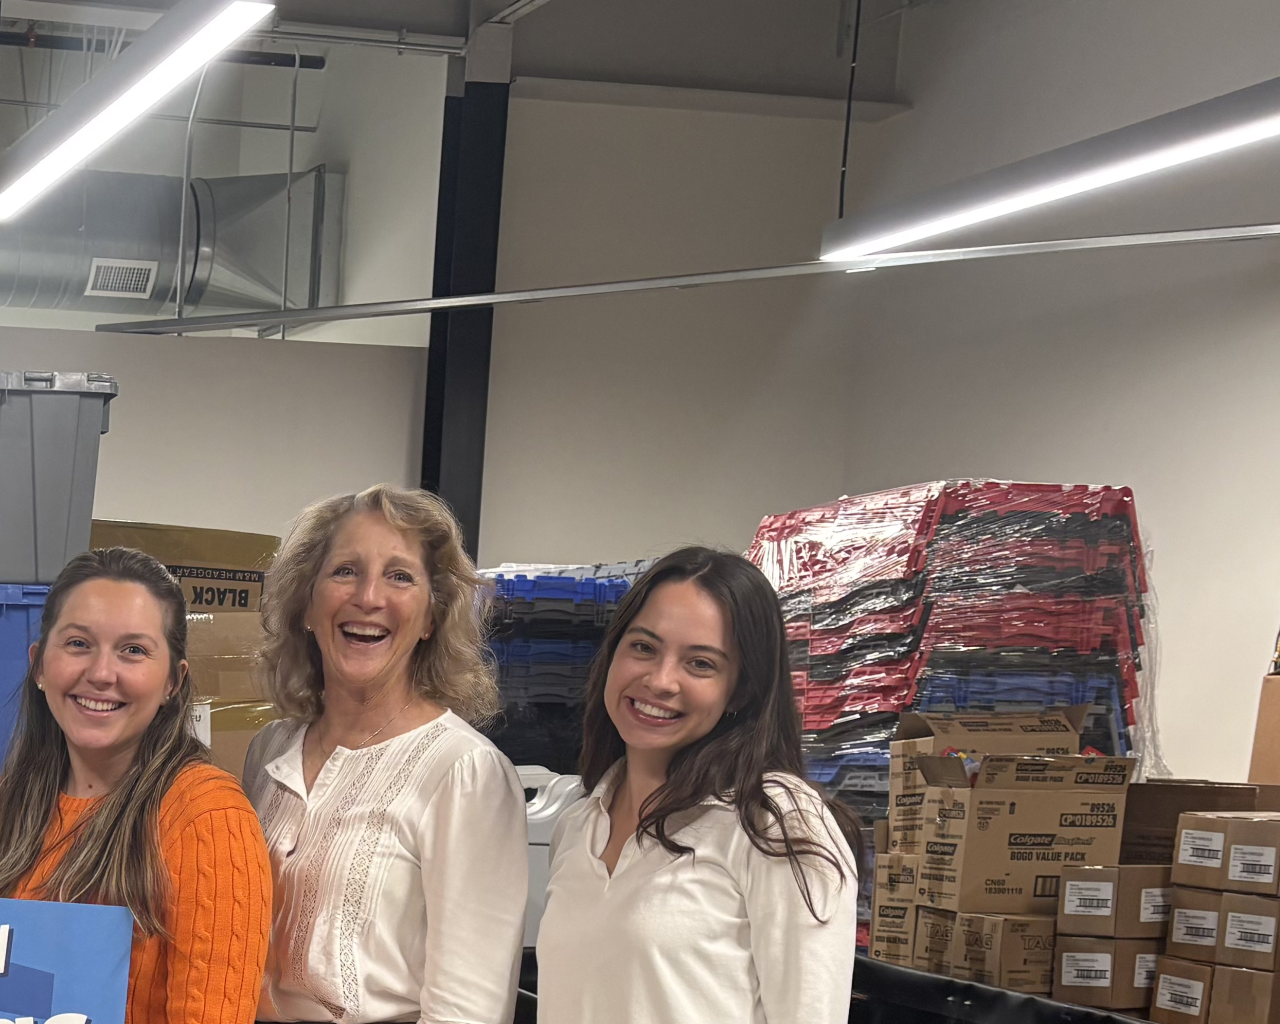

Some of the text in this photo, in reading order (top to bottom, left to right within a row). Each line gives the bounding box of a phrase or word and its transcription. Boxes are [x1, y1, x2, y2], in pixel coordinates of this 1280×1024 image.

[235, 572, 258, 581] M&M
[192, 586, 249, 607] BLACK
[1090, 803, 1115, 813] 89526
[1010, 835, 1052, 845] Colgate
[1010, 852, 1086, 861] BOGO VALUE PACK
[924, 922, 953, 941] TAG
[963, 930, 993, 950] TAG
